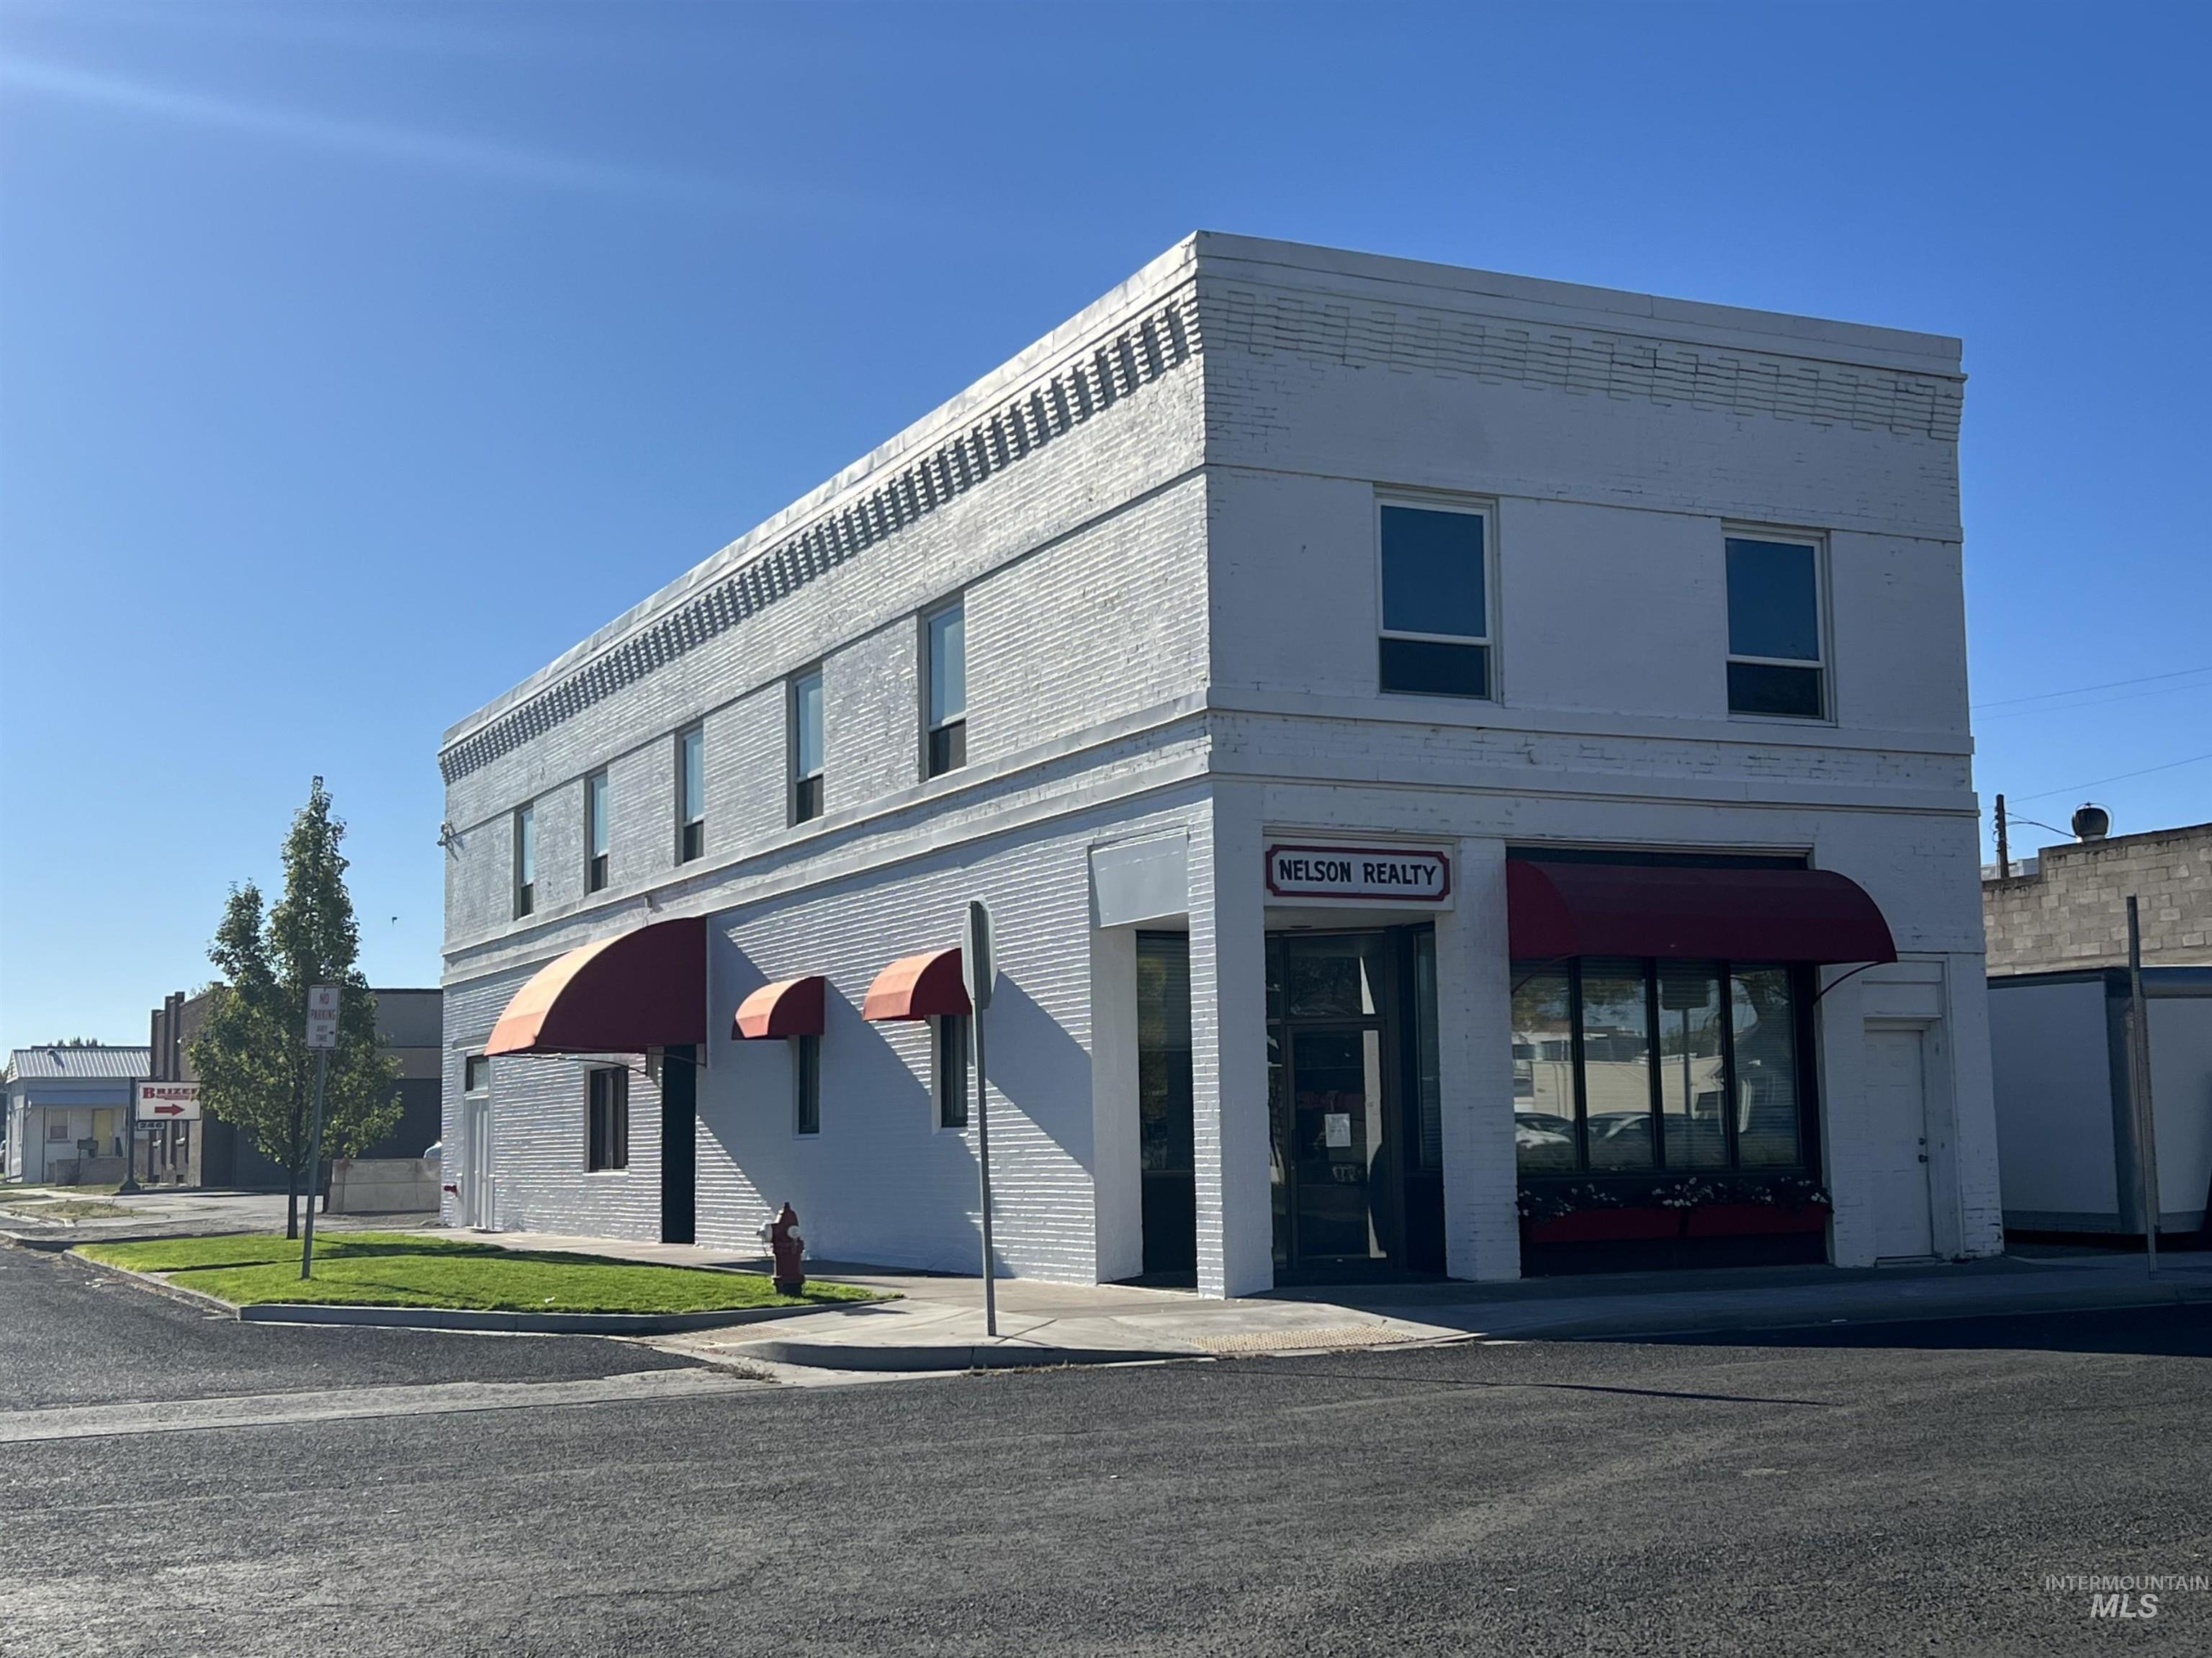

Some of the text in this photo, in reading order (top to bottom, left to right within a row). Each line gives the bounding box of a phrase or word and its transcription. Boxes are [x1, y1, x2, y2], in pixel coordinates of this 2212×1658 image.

[1278, 859, 1438, 886] NELSON REALTY
[319, 993, 330, 1005] NO
[310, 1009, 336, 1020] PARKING
